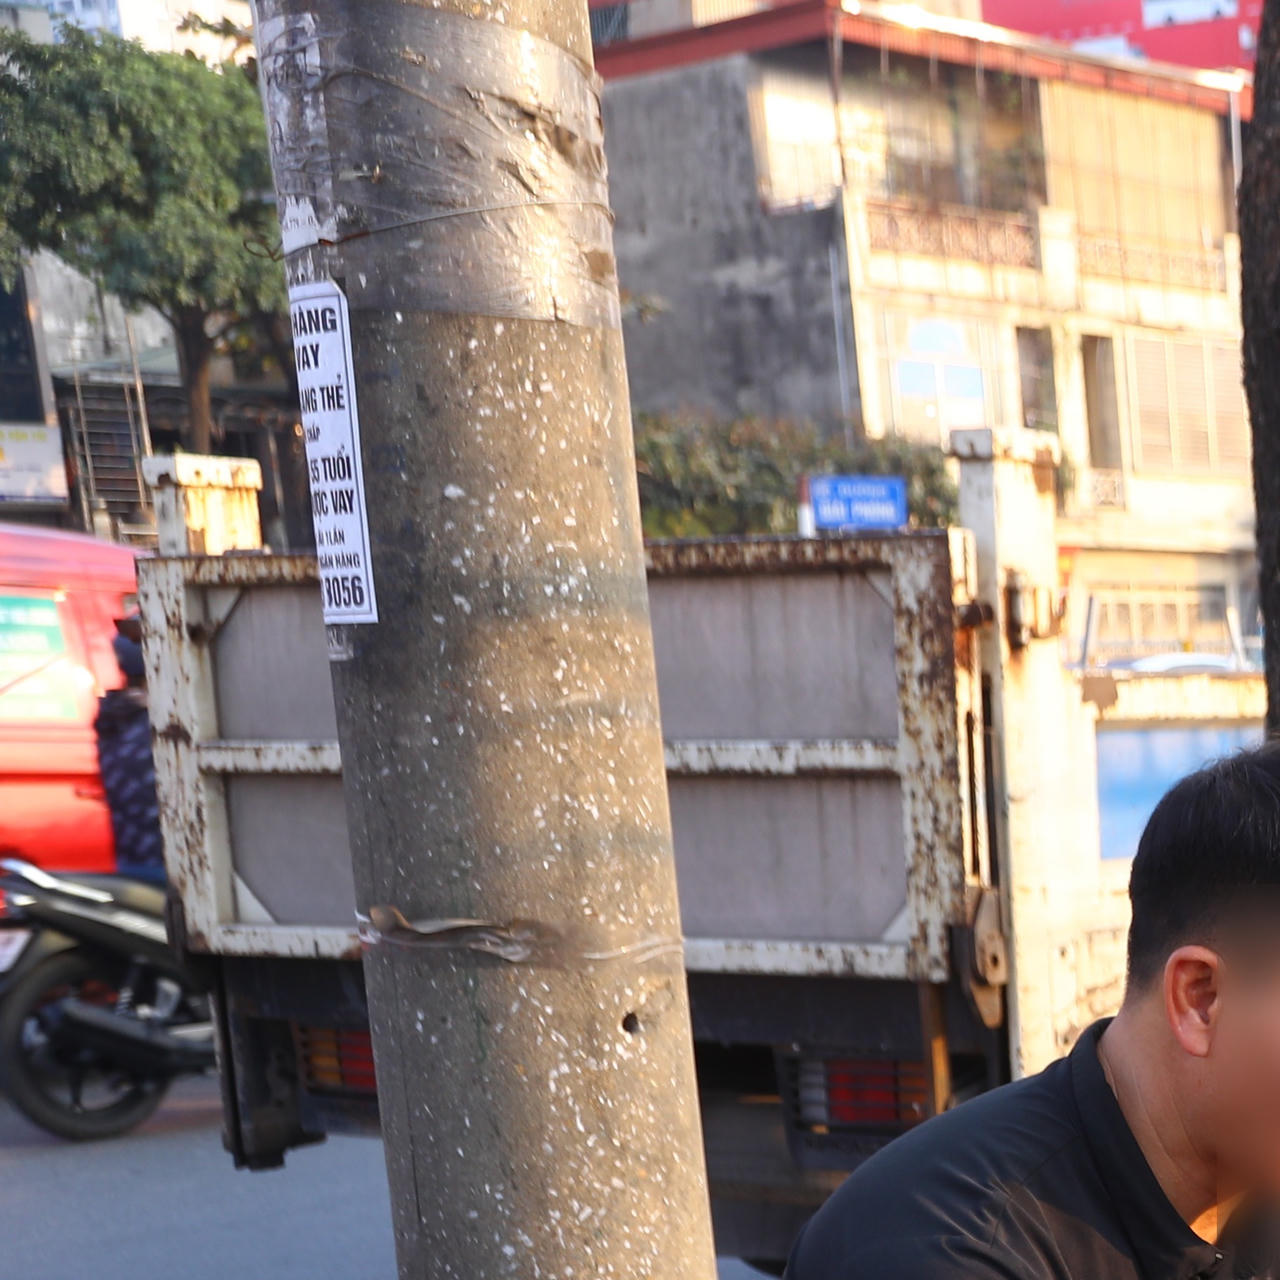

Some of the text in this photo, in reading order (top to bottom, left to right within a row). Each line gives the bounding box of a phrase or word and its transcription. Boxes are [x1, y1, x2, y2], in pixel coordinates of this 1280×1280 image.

[320, 373, 345, 412] THẺ
[321, 444, 352, 482] TUỔI
[330, 489, 355, 516] VAY
